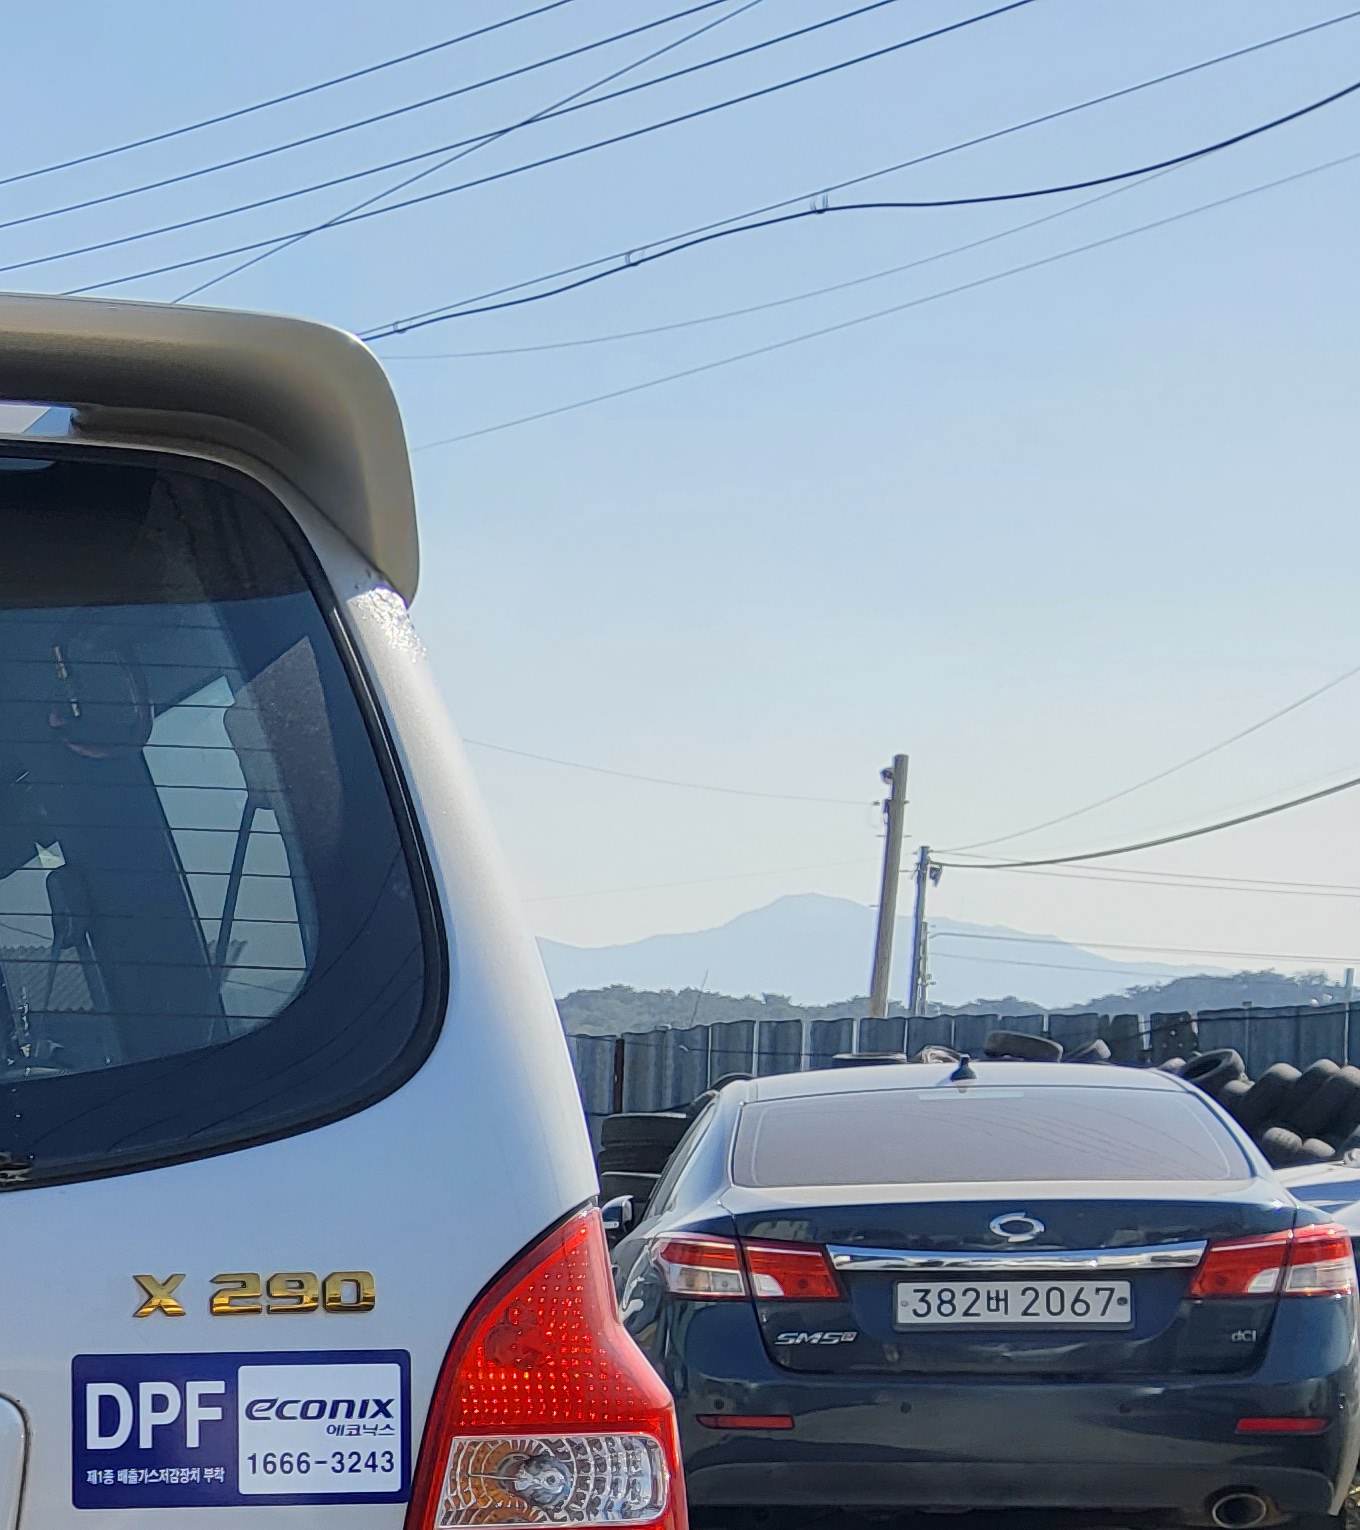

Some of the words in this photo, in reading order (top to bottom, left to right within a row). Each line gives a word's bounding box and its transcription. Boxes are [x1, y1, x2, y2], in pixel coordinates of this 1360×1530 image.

[132, 1273, 186, 1317] X
[209, 1271, 376, 1316] 290
[912, 1287, 1009, 1318] 382버
[1020, 1286, 1116, 1317] 2067
[86, 1380, 226, 1450] DPF
[326, 1424, 395, 1437] 에코닉스
[85, 1469, 115, 1485] 제1종
[117, 1468, 201, 1485] 배출가스저감장치
[203, 1467, 226, 1484] 부착
[247, 1450, 395, 1475] 1666-3243
